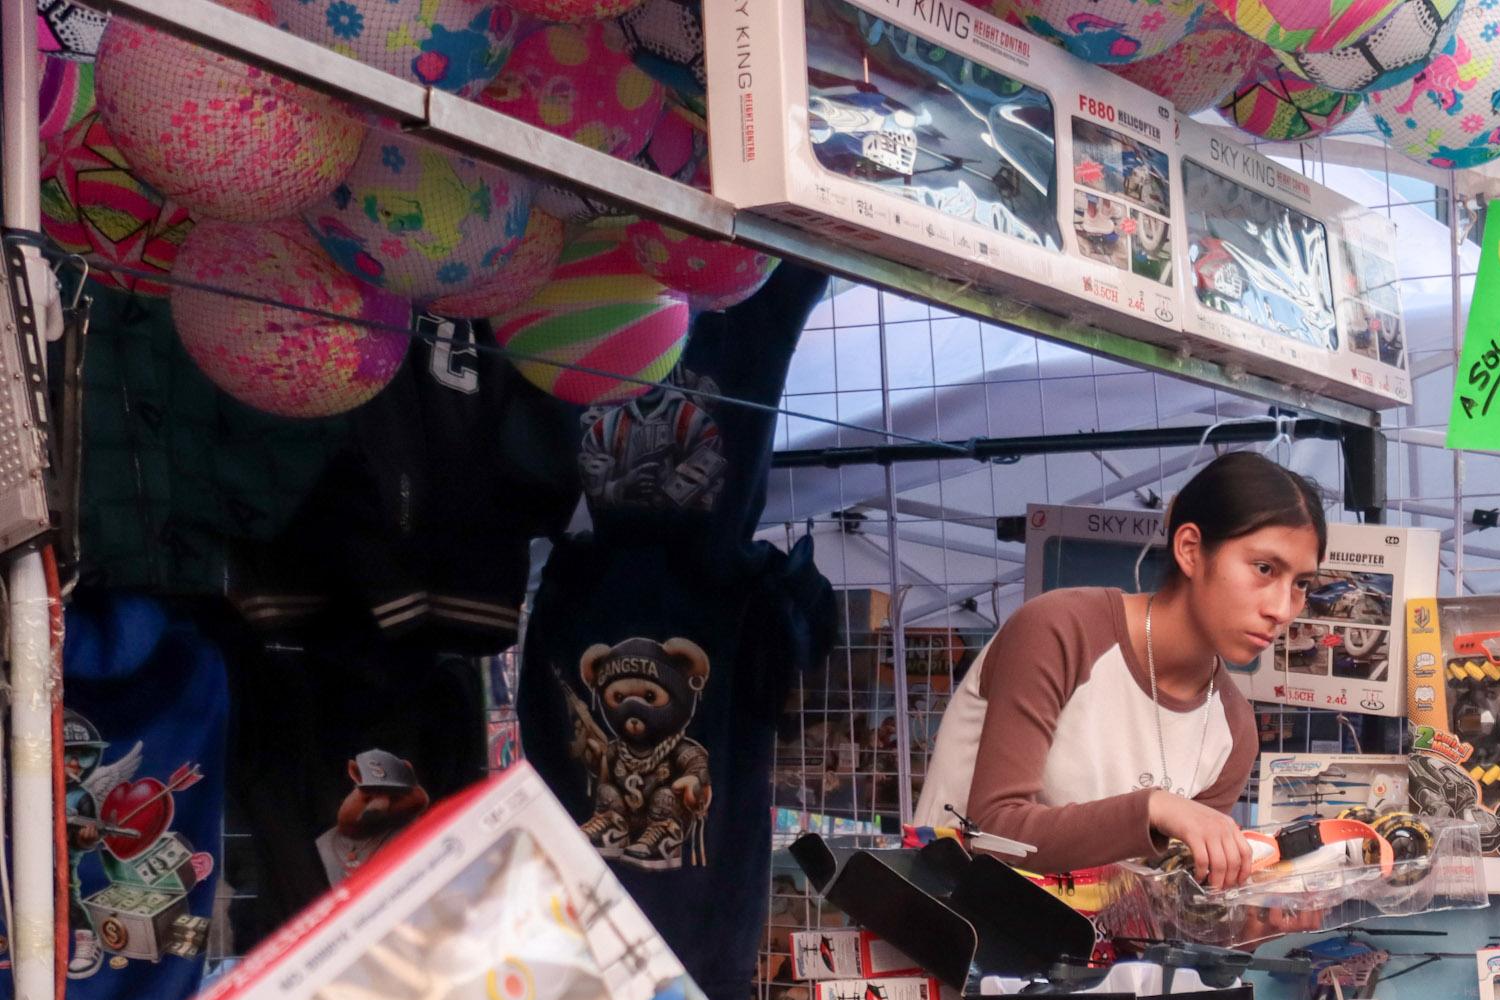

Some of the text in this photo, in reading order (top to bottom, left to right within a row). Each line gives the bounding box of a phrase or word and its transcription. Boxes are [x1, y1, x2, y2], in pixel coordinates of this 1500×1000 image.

[974, 20, 1000, 45] HEIGHT
[1000, 30, 1031, 58] CONTROL
[736, 26, 752, 90] KING
[1079, 95, 1161, 140] F880 HELICOPTER
[1210, 138, 1238, 172] SKY
[1241, 151, 1275, 188] KING
[1459, 394, 1479, 419] A
[1088, 514, 1168, 538] SKY KIN
[1329, 551, 1385, 566] HELICOPTER
[602, 657, 660, 686] GANGSTA
[1414, 726, 1436, 749] 2
